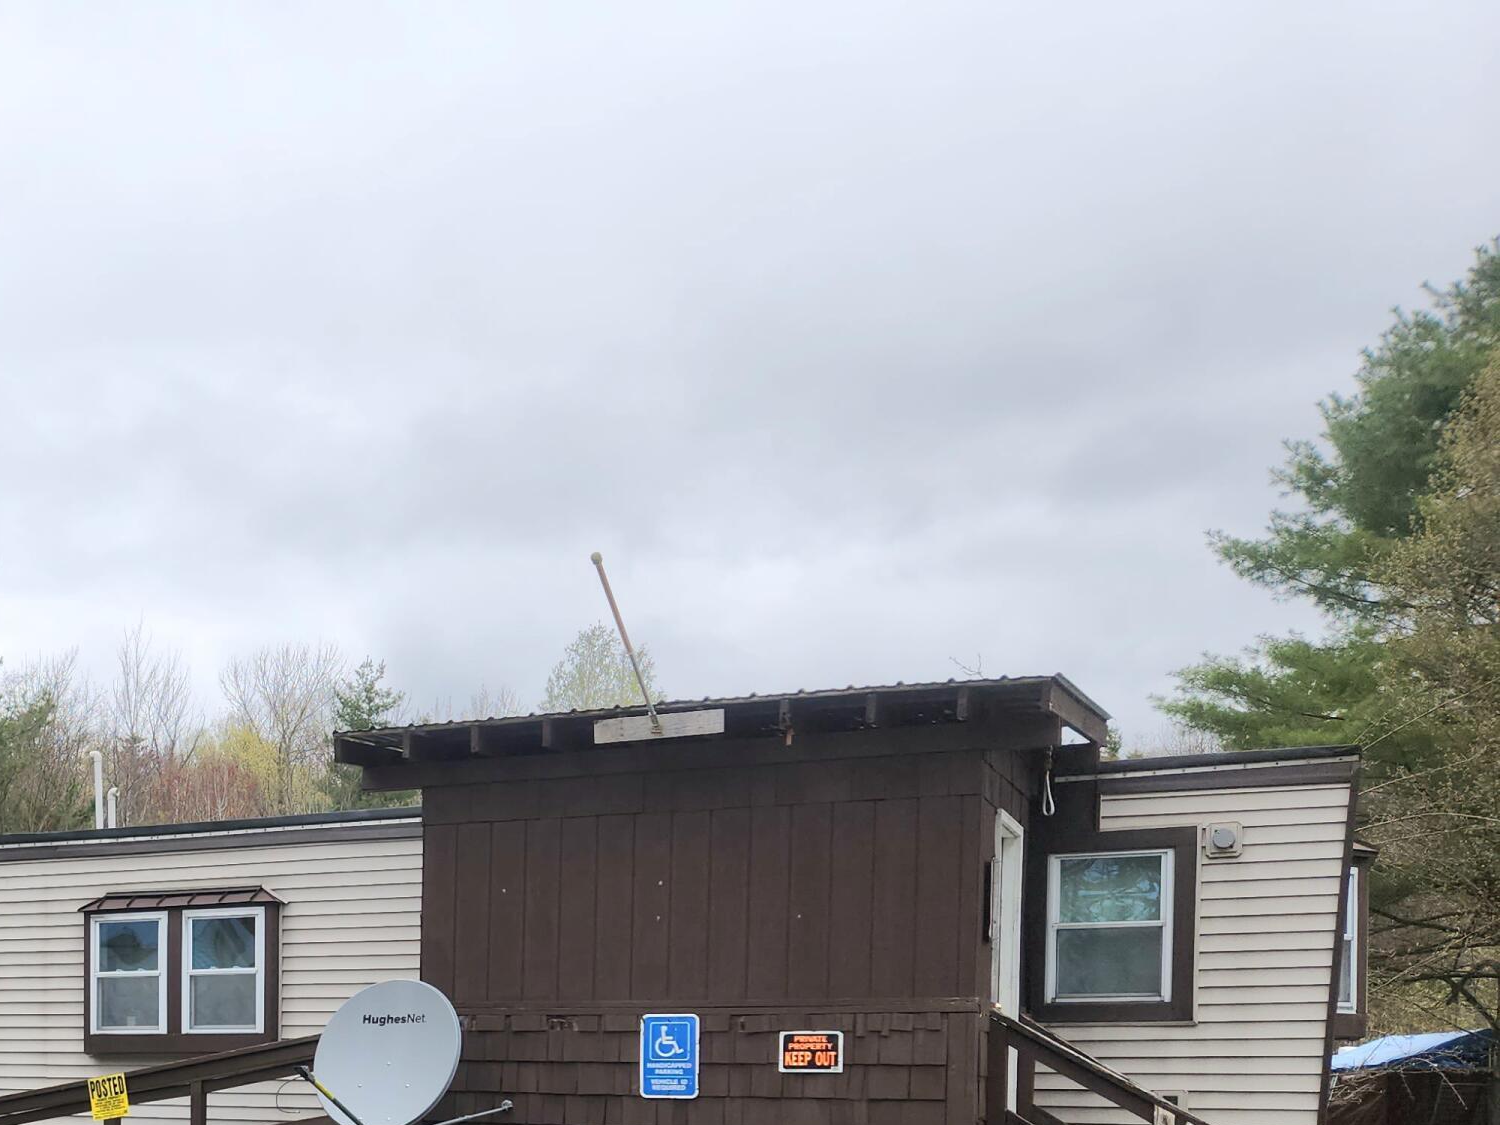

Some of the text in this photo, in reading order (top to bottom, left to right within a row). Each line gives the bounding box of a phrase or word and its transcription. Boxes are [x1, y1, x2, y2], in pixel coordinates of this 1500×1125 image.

[784, 1051, 837, 1066] KEEP OUT
[89, 1075, 125, 1099] POSTED
